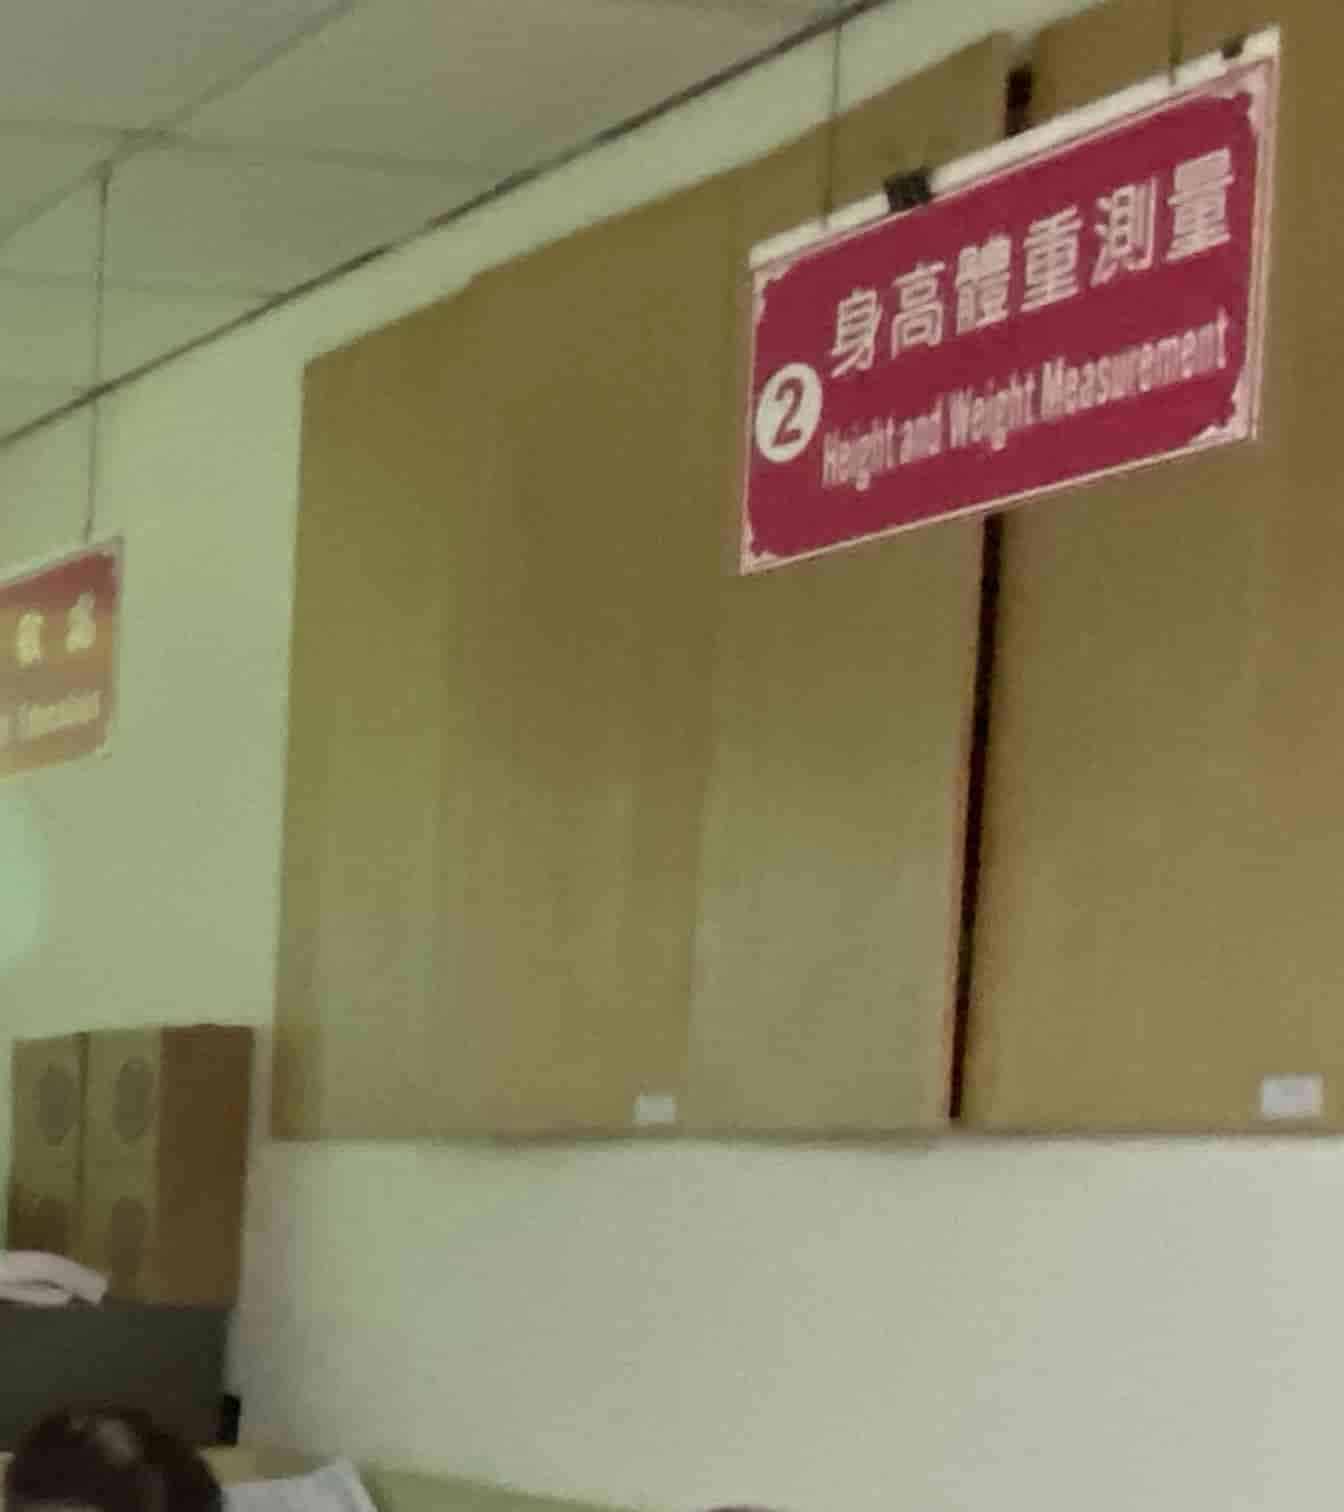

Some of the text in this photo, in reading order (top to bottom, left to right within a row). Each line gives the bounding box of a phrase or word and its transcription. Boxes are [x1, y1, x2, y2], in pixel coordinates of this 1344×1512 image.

[830, 148, 1234, 378] 身高體重測量
[821, 307, 1229, 491] Height and Weight Measurement
